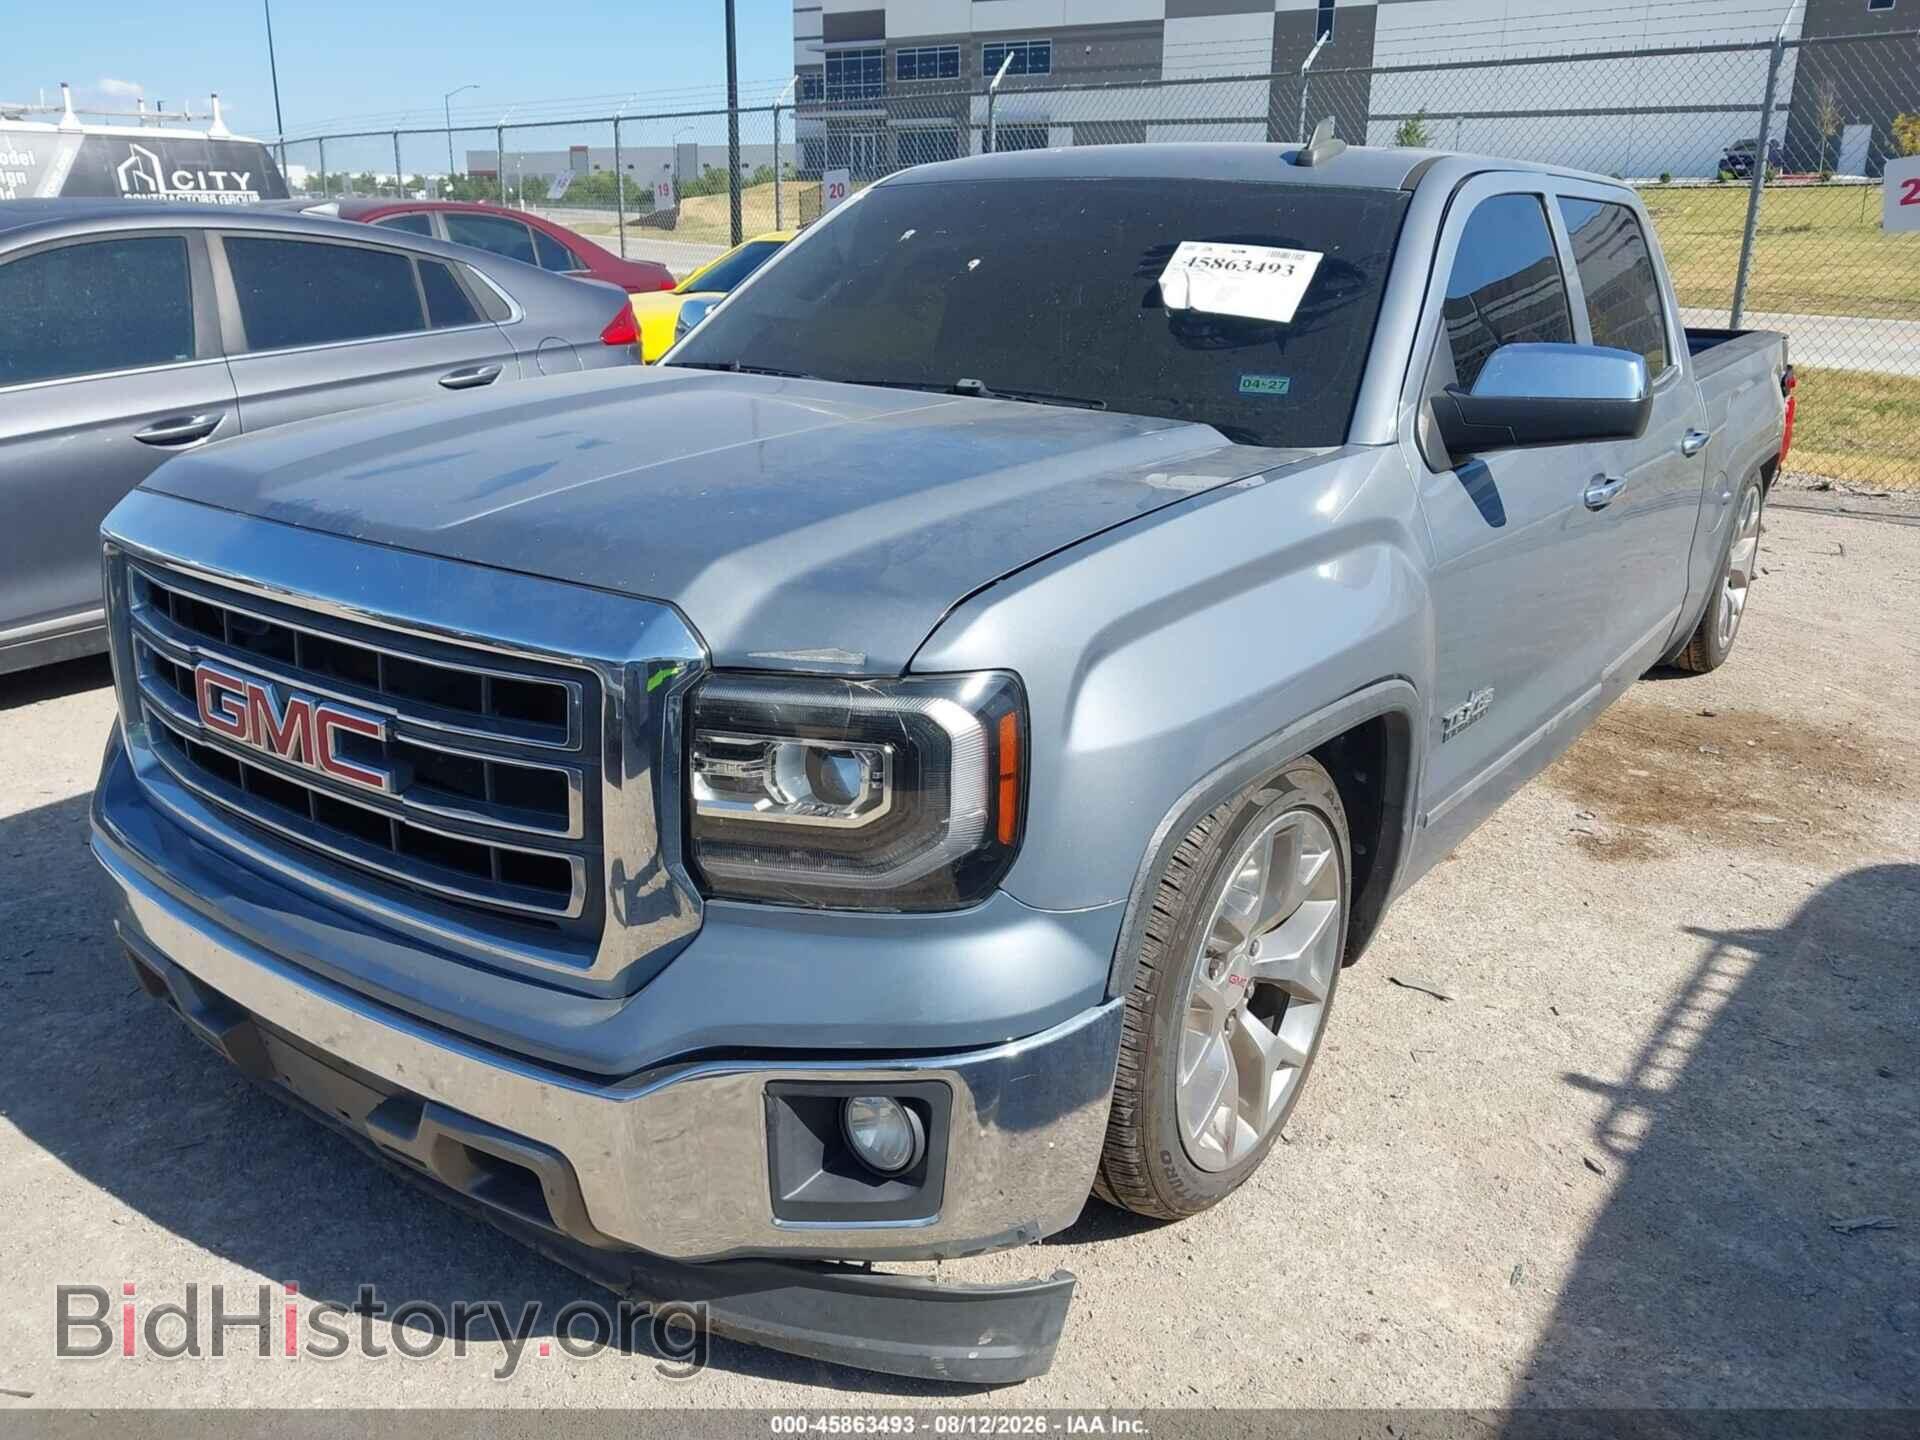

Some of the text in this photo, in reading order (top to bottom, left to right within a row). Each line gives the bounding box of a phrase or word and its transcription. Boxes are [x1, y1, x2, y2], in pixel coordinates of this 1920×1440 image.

[171, 170, 251, 191] CITY
[657, 182, 670, 198] 19
[829, 182, 845, 199] 20
[1183, 255, 1296, 278] 45863493
[1242, 379, 1287, 390] 04-27
[195, 659, 392, 792] GMC
